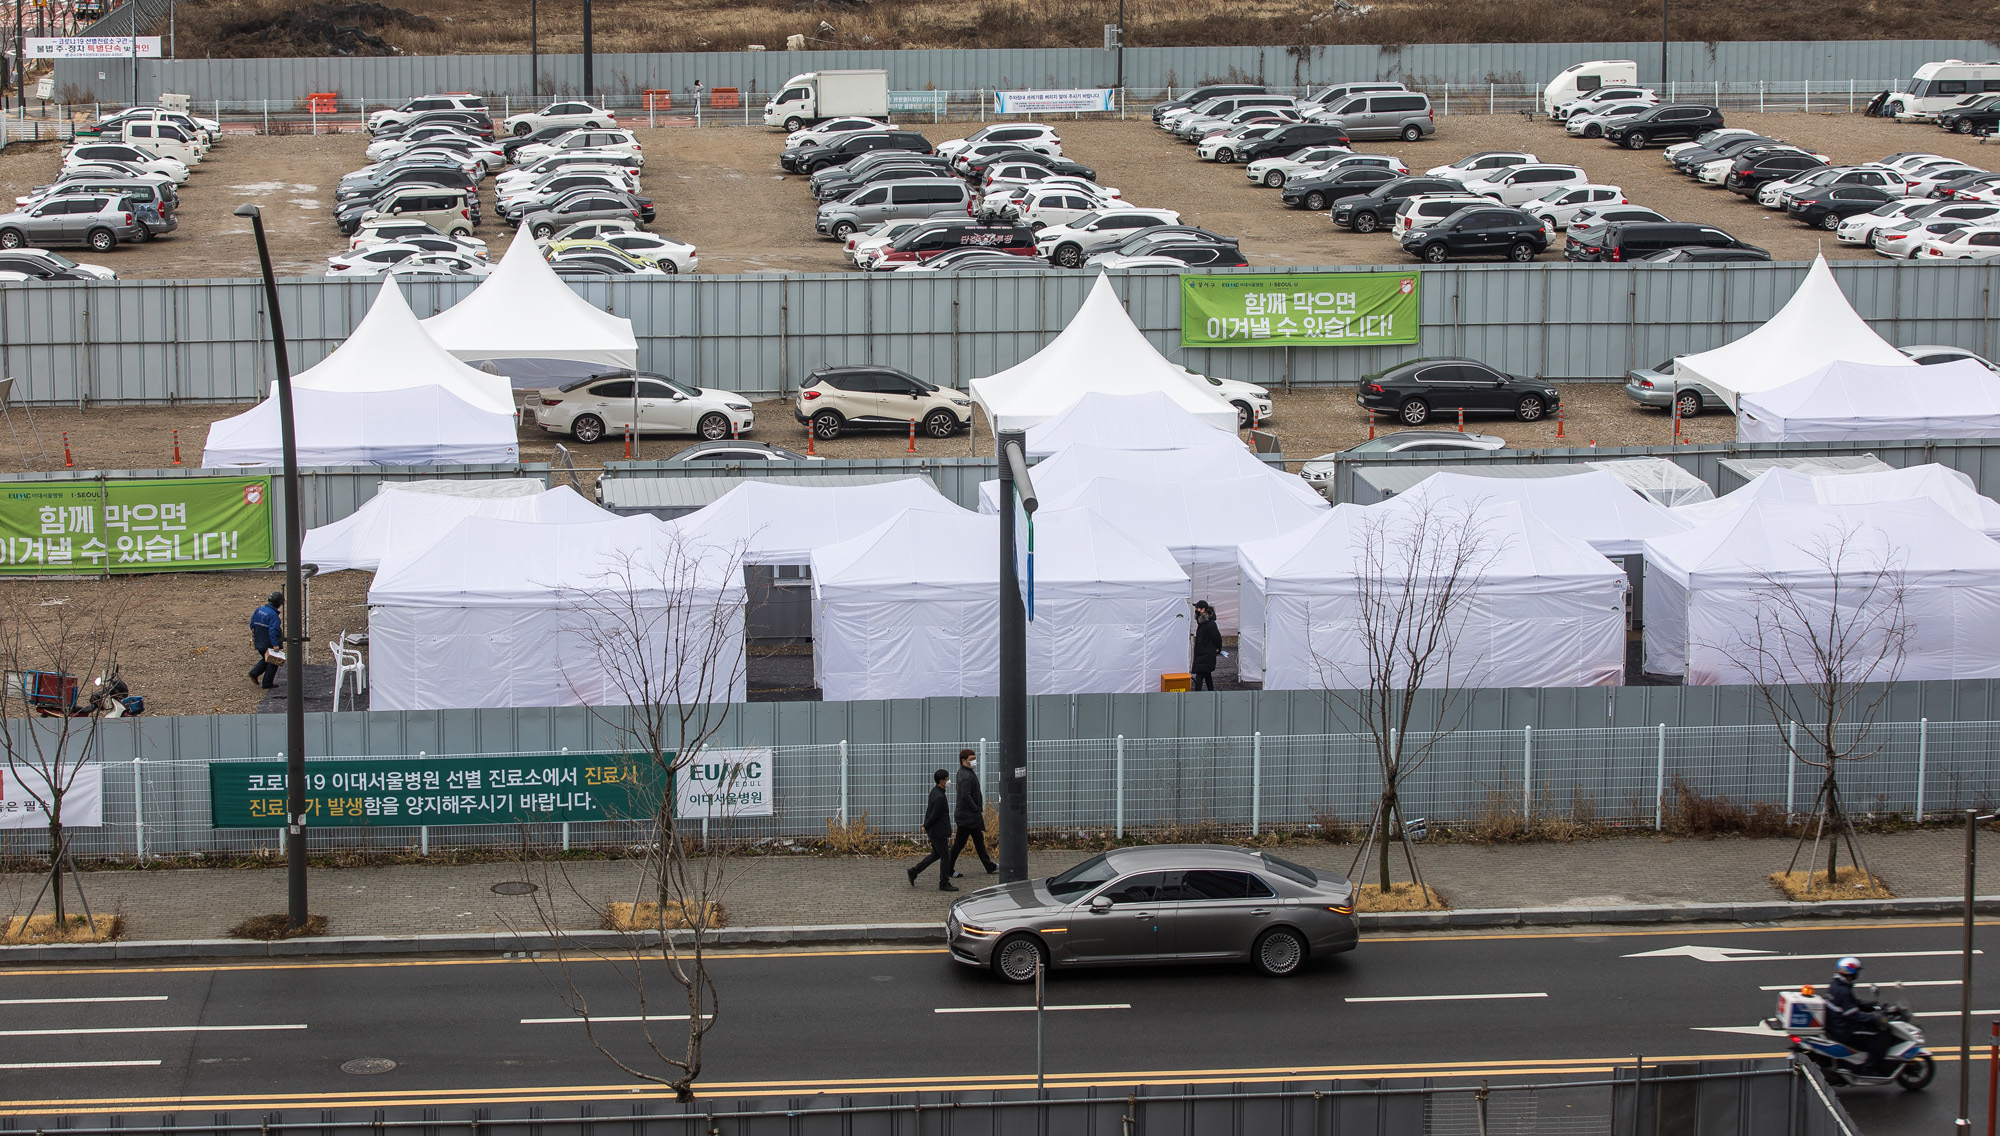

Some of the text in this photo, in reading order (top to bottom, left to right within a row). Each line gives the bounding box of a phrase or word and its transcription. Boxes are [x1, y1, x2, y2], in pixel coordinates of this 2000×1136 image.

[36, 45, 54, 53] 불법
[87, 44, 122, 52] 특별단속
[1244, 291, 1356, 316] 함께 막으면
[1206, 314, 1393, 339] 이겨낼 수 있습니다!
[39, 502, 187, 535] 함께 막으면
[81, 537, 106, 565] 수
[117, 530, 238, 564] 있습니다!
[248, 773, 326, 791] 코로19
[332, 771, 440, 791] 이대서울병원
[446, 769, 482, 790] 선별
[488, 766, 578, 788] 진료소에서
[249, 791, 597, 818] 진료가 발생함을 양지해주시기 바랍니다.
[690, 792, 762, 806] 이대서울병원
